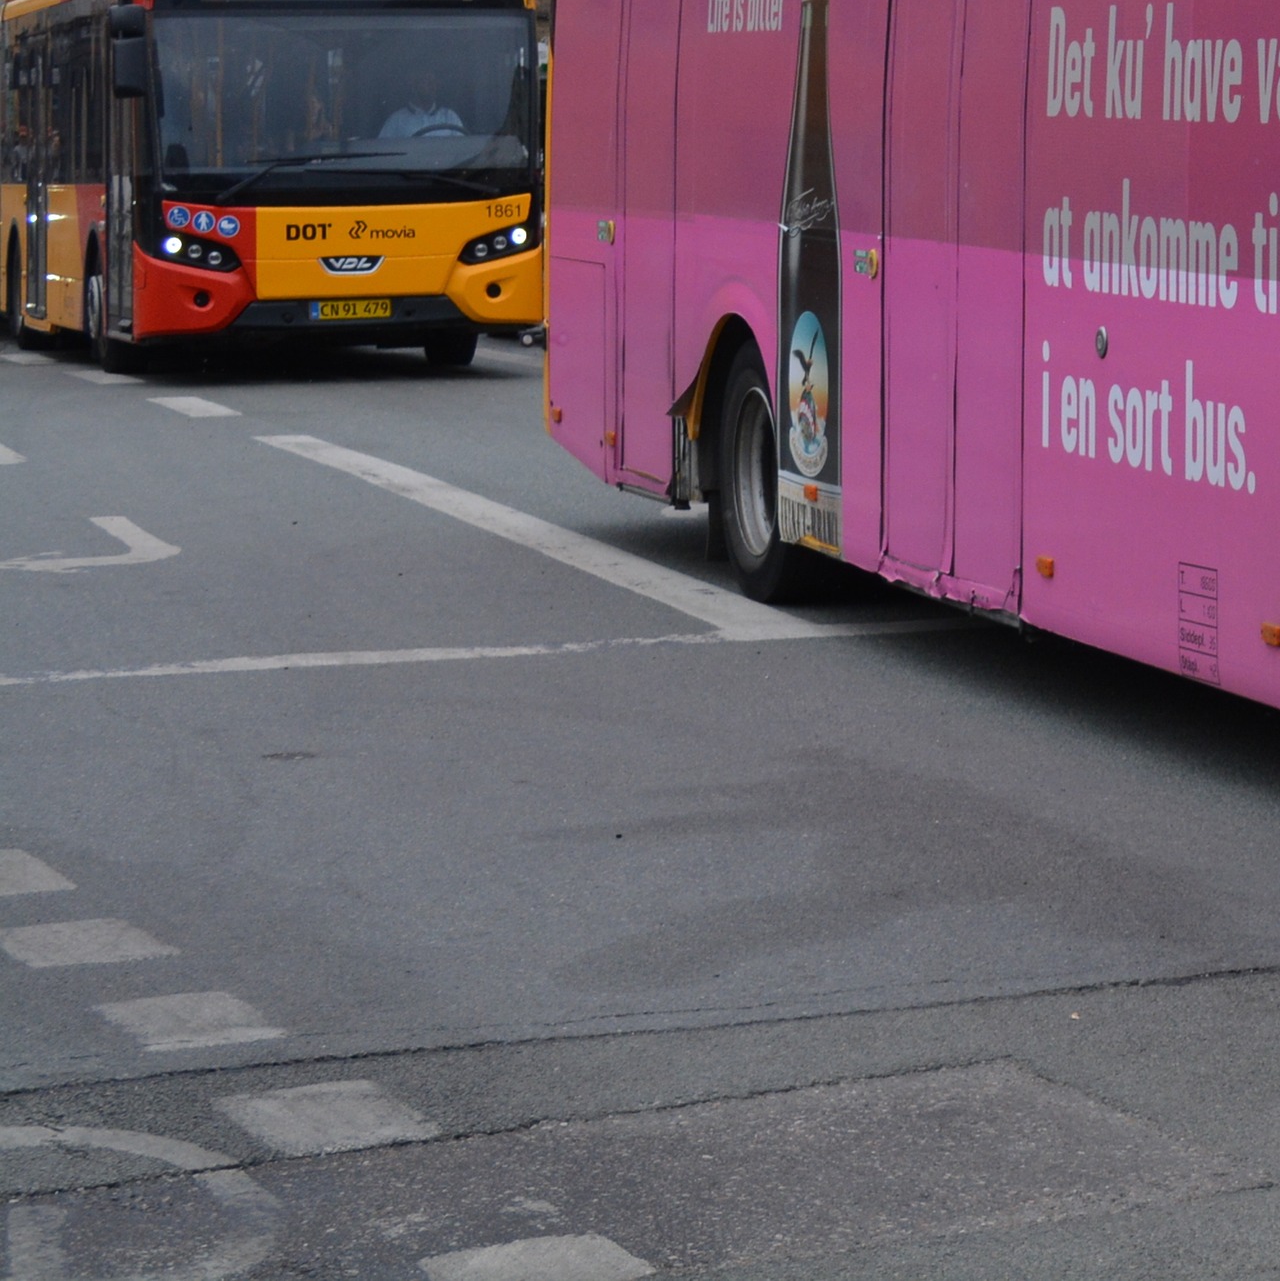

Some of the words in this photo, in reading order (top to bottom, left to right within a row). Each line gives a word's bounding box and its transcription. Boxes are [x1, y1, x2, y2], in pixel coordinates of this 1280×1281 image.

[1047, 6, 1096, 117] Det
[1163, 2, 1243, 123] have
[485, 203, 522, 218] 1861
[286, 223, 332, 241] DOT
[369, 225, 416, 240] movia
[1043, 196, 1073, 289] at
[1083, 178, 1238, 309] ankomme
[328, 257, 374, 270] VDL
[320, 300, 340, 317] CN
[342, 299, 358, 316] 91
[363, 298, 389, 315] 479
[1041, 339, 1050, 448] i
[1060, 374, 1097, 459] en
[1107, 379, 1173, 476] sort
[1184, 359, 1256, 495] bus.
